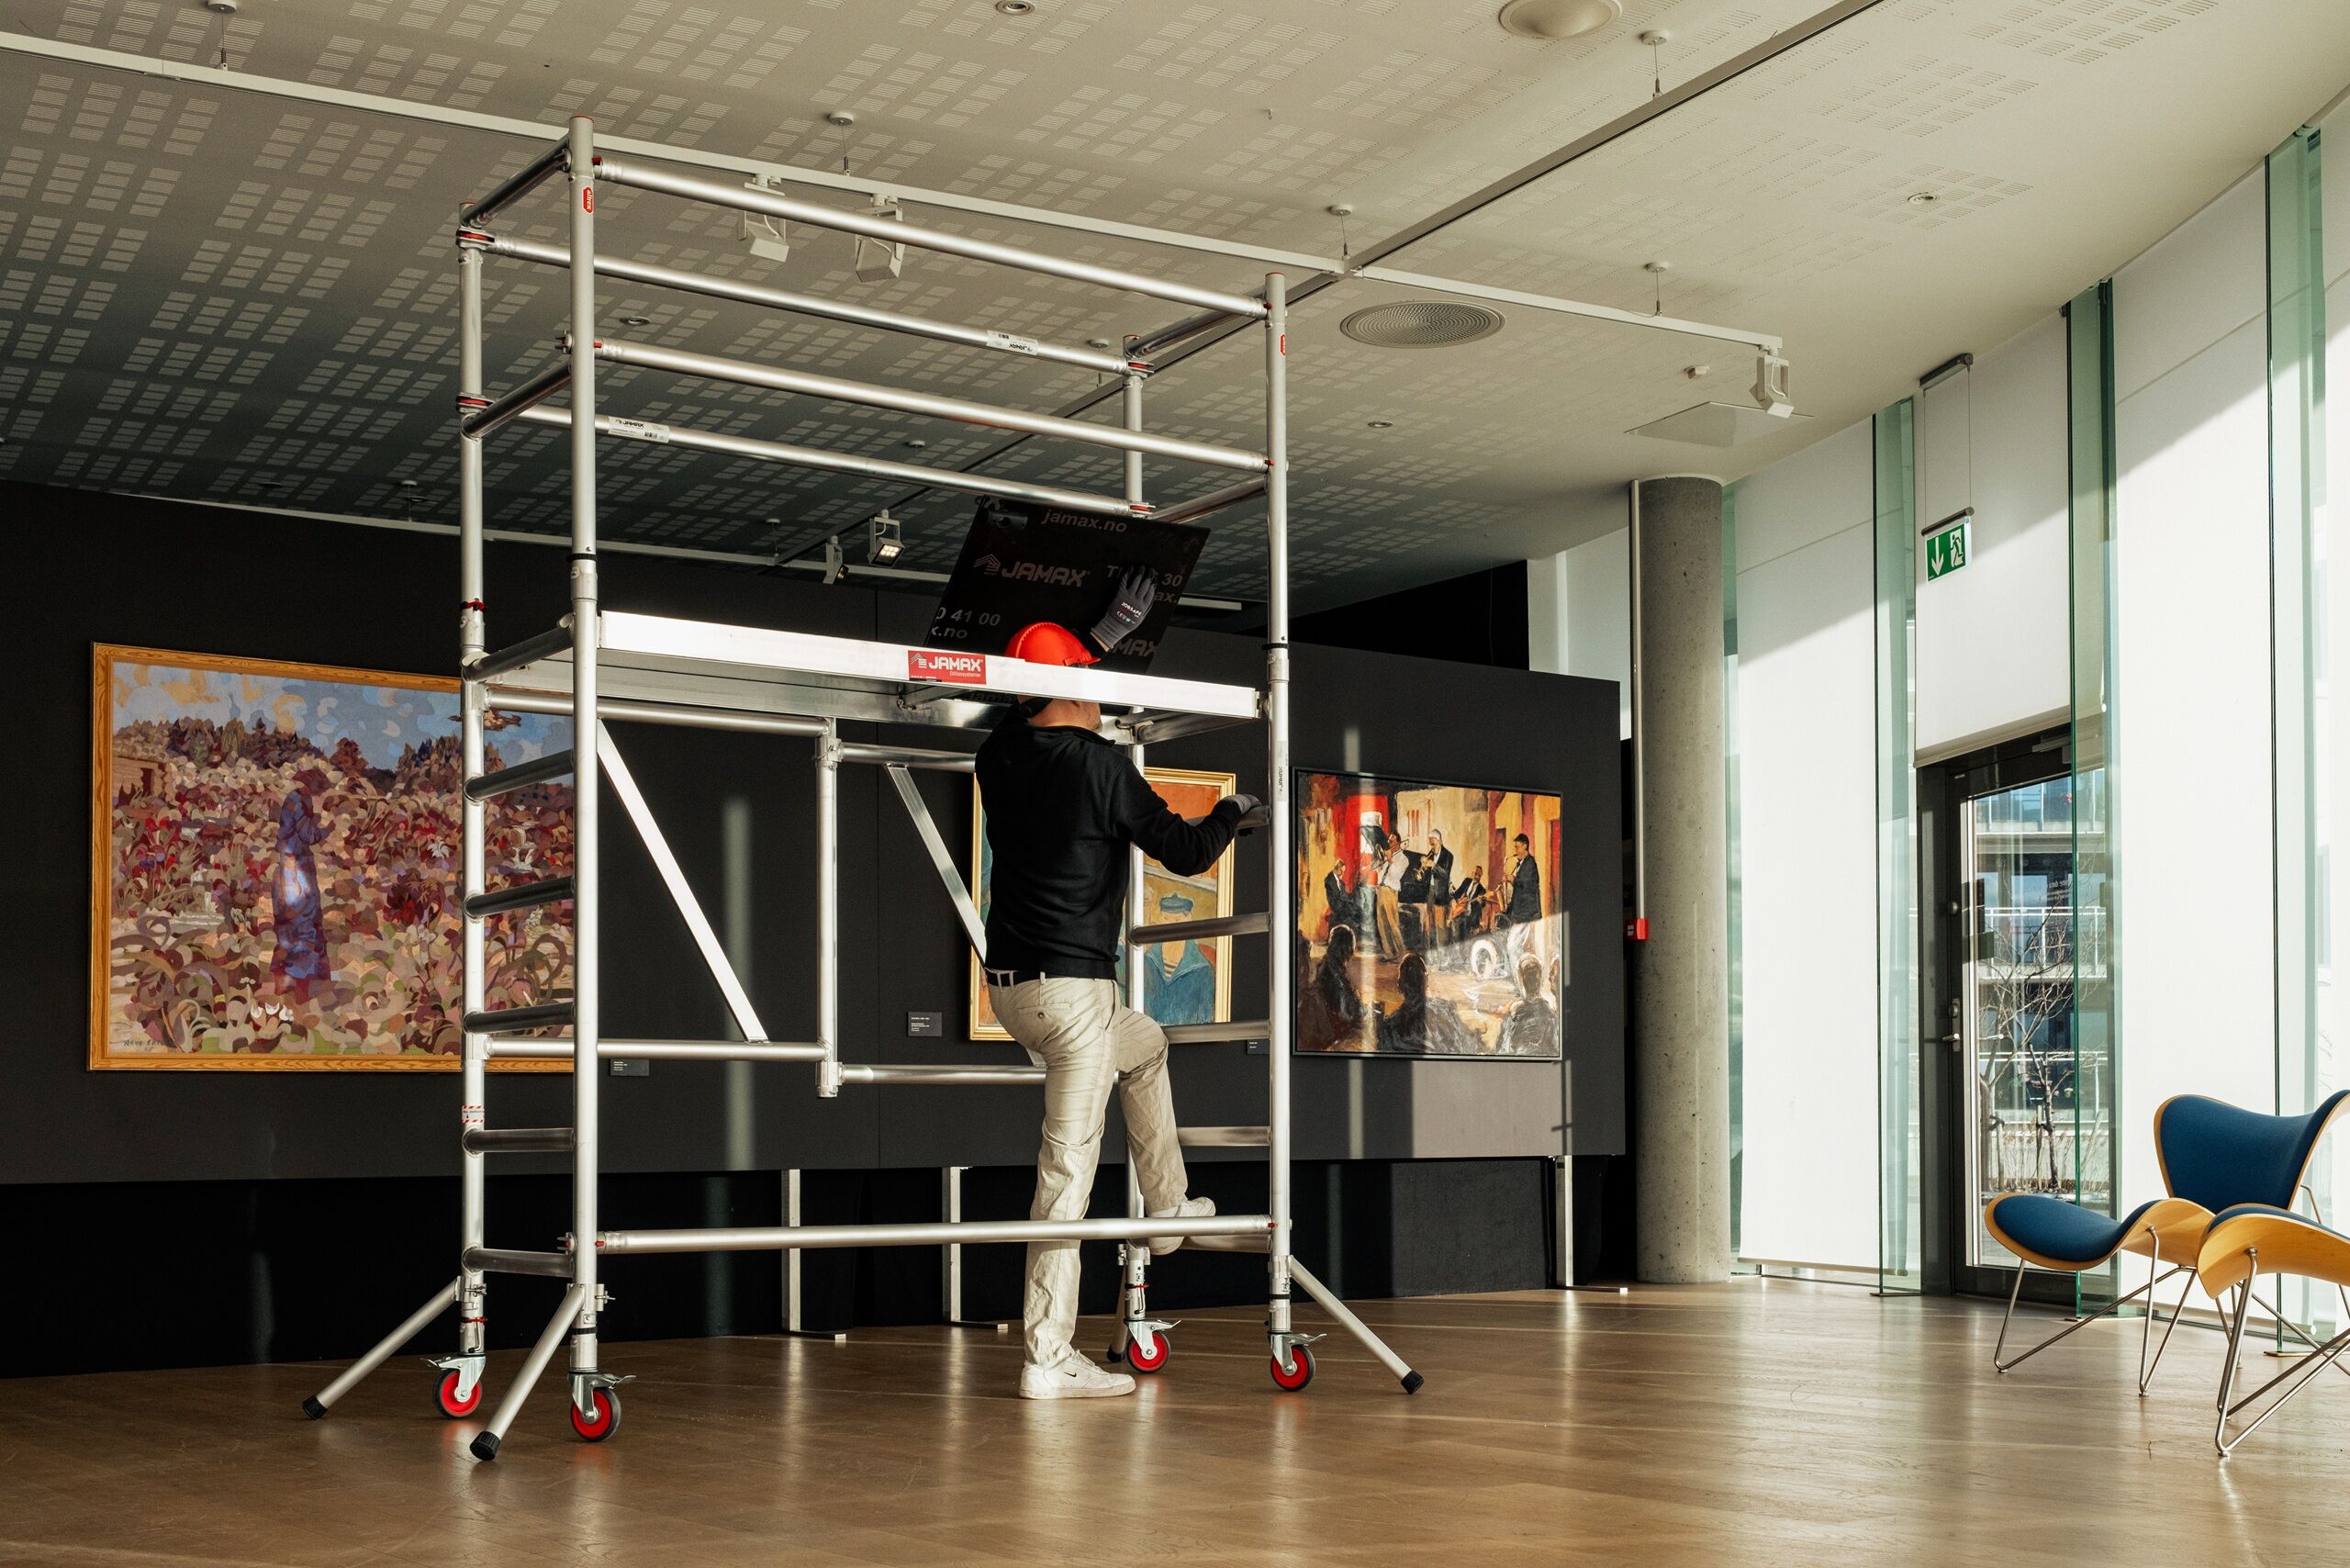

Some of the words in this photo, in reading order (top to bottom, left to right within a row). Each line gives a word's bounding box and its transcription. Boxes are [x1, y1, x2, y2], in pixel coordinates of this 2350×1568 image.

[1041, 509, 1127, 532] jamax.no
[1001, 560, 1087, 588] JAMAX
[1160, 573, 1183, 588] 30
[950, 609, 973, 623] 41
[979, 612, 1002, 626] 00
[1112, 638, 1160, 657] MAX
[928, 656, 981, 672] JAMAX
